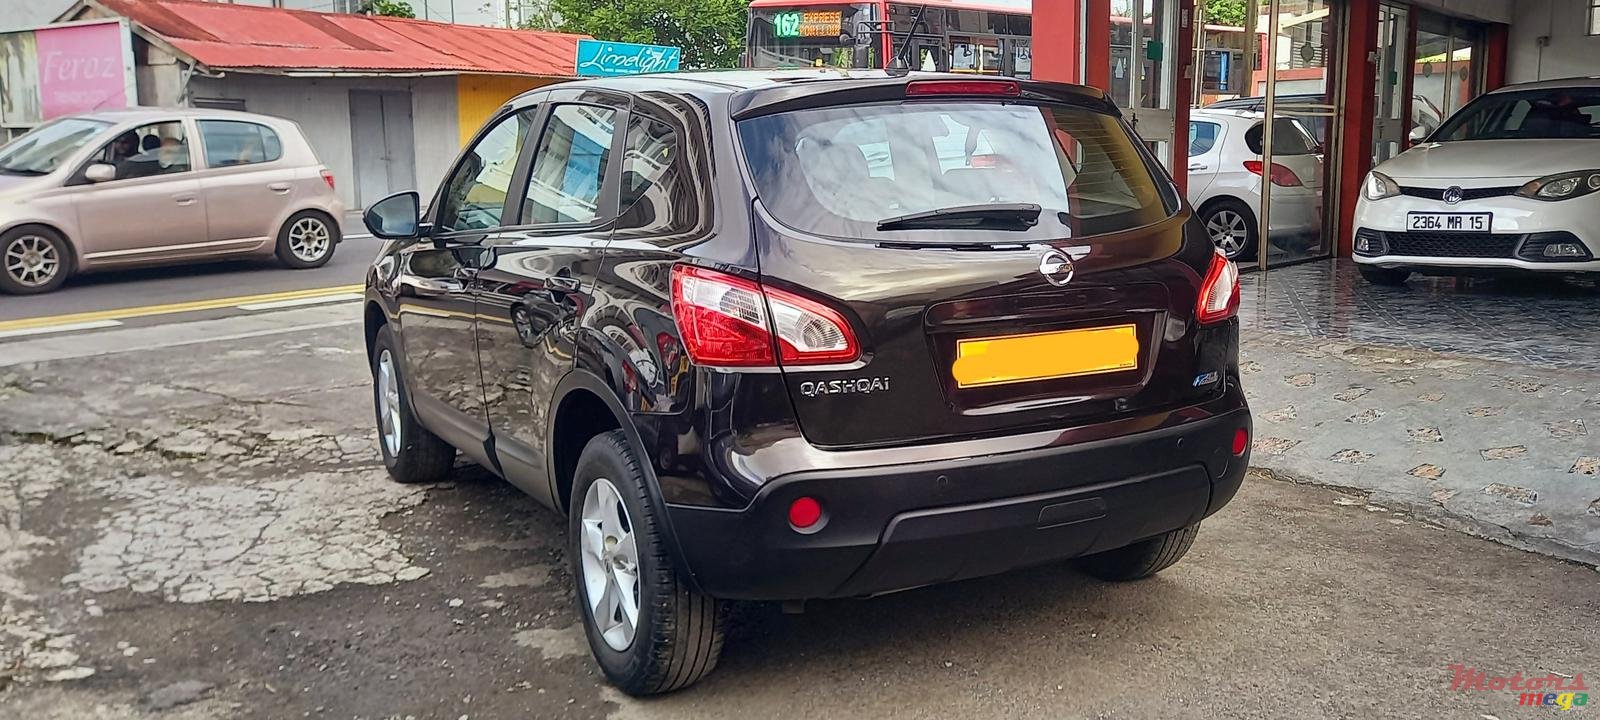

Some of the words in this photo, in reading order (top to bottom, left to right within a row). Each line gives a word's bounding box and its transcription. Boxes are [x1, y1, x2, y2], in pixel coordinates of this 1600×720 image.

[774, 13, 799, 36] 162
[803, 12, 840, 24] EXPRESS
[44, 51, 116, 84] Feroz
[579, 44, 678, 73] Limelight
[1413, 216, 1441, 229] 2364
[1447, 216, 1462, 229] MR
[1469, 216, 1483, 229] 15
